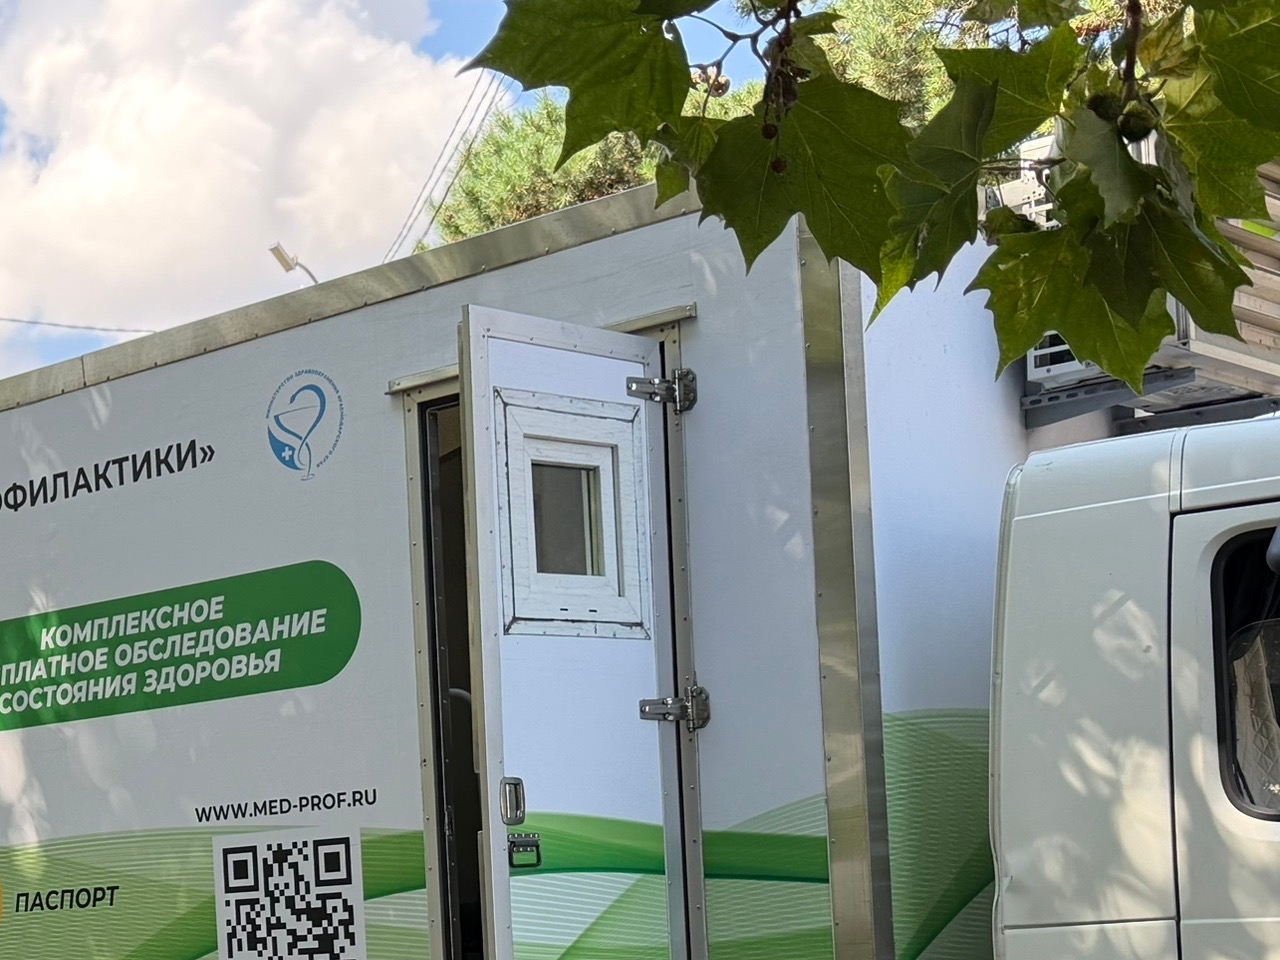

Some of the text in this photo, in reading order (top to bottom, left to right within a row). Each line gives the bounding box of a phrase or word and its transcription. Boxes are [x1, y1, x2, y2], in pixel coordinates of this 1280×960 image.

[40, 595, 225, 650] КОМПЛЕКСНОЕ
[114, 608, 328, 668] ОБСЛЕДОВАНИЕ
[142, 648, 281, 694] ЗДОРОВЬЯ
[195, 788, 378, 823] WWW.MED-PROF.RU
[15, 886, 120, 913] ПАСПОРТ
